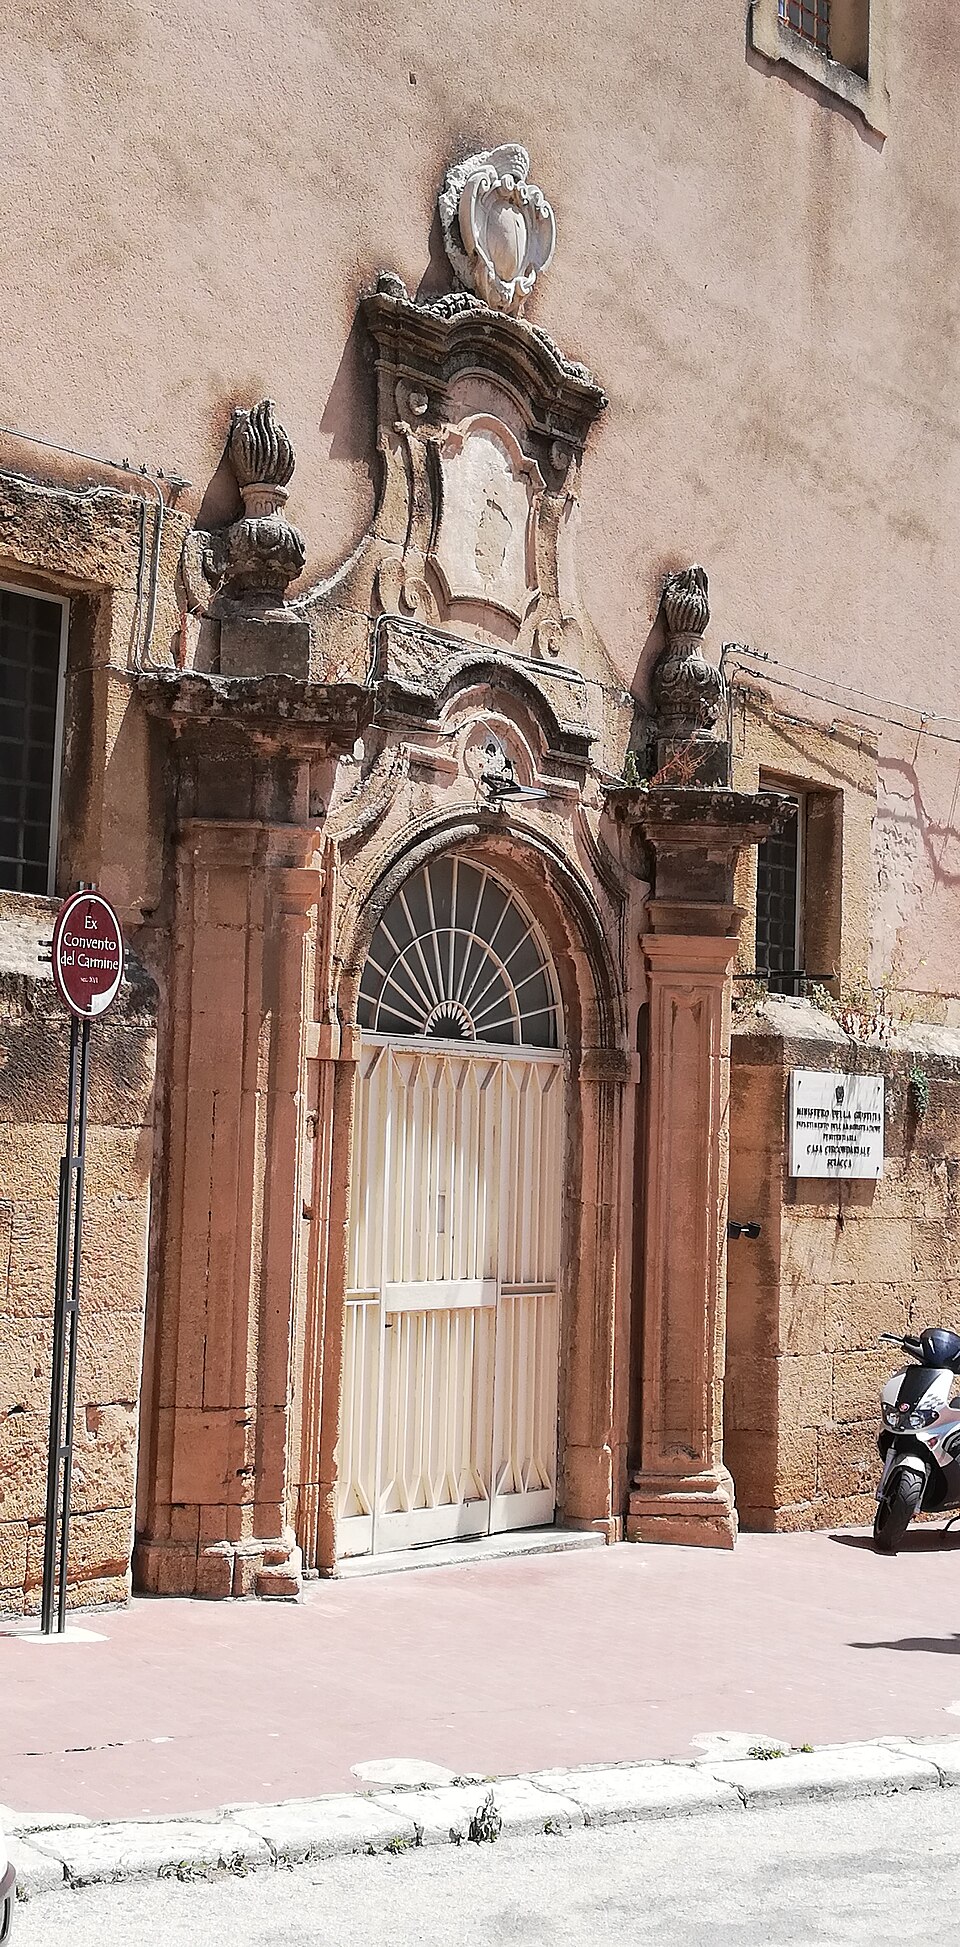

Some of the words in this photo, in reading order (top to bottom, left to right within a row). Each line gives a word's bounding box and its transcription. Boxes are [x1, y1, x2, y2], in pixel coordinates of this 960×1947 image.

[84, 915, 98, 930] Ex
[63, 932, 117, 951] Convento
[60, 950, 75, 967] del
[77, 953, 119, 970] Carmine
[796, 1107, 829, 1119] MINISTERO
[832, 1109, 851, 1120] DELLA
[854, 1111, 882, 1122] GIUSTIZIA
[806, 1144, 823, 1155] CASA
[824, 1145, 871, 1157] CIRCONDARIALE
[827, 1158, 852, 1169] SCIACCA
